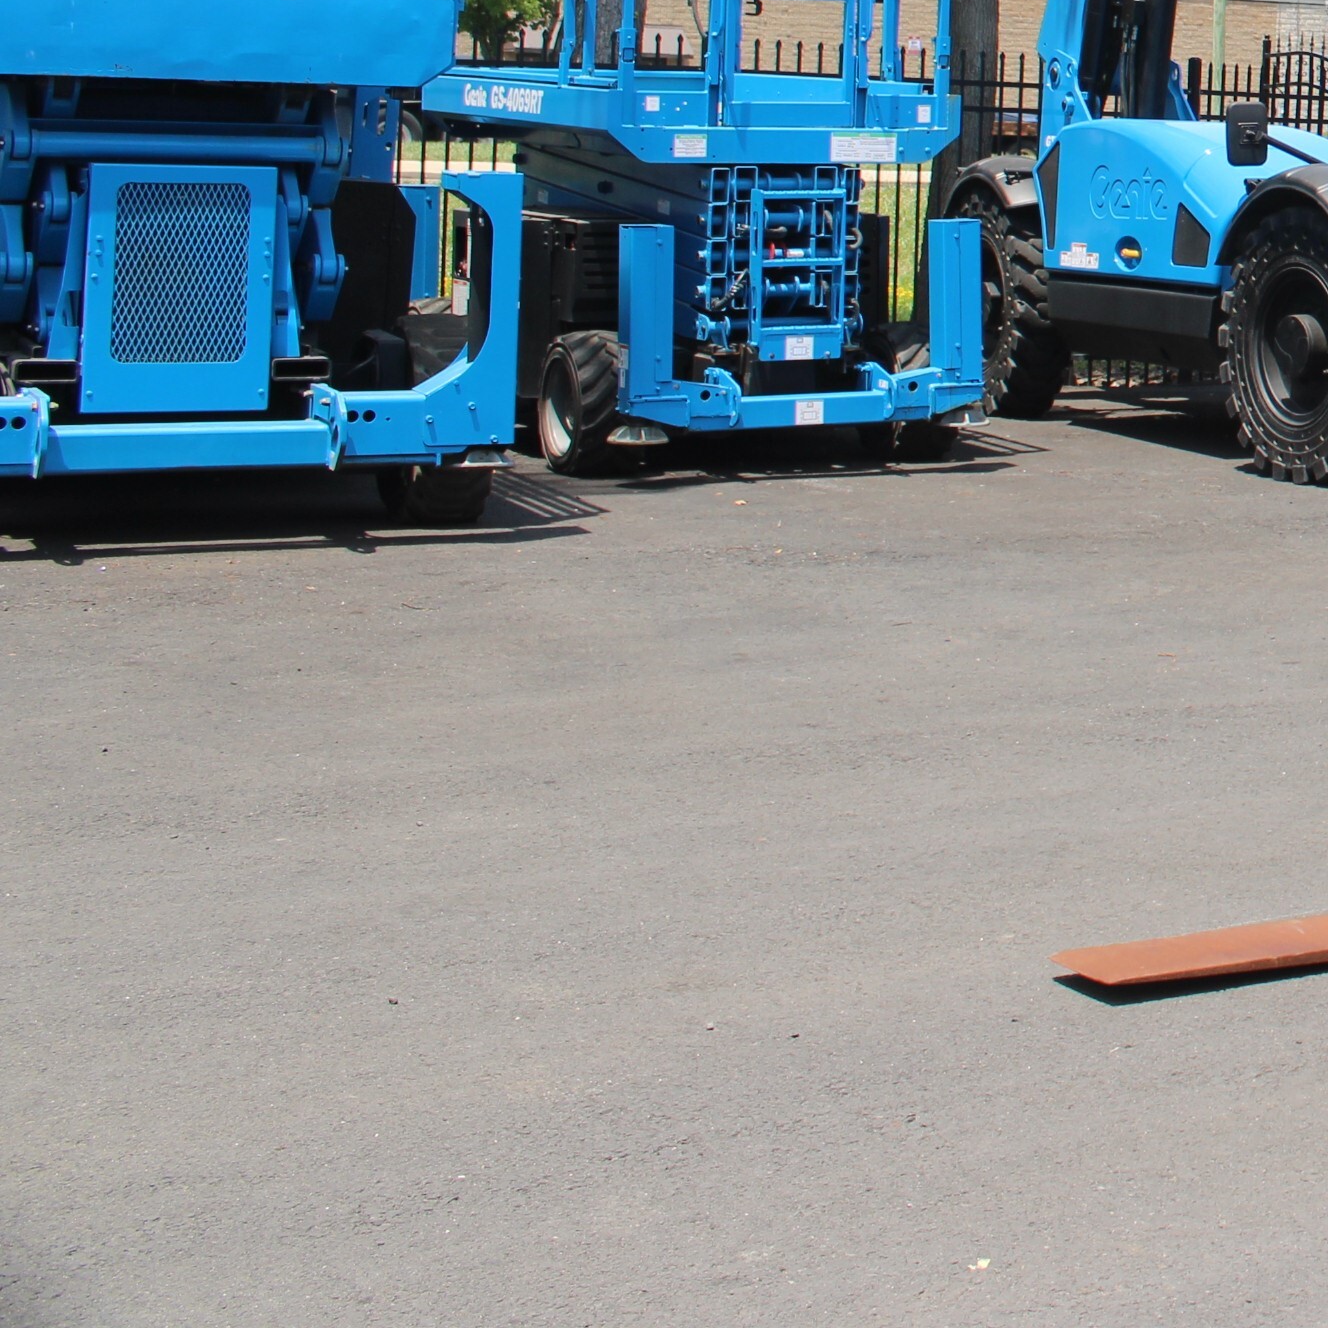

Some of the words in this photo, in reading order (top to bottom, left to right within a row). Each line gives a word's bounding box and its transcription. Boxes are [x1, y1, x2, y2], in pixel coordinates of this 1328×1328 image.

[464, 83, 487, 108] Genie
[491, 85, 544, 114] GS-4069RT
[1089, 164, 1168, 220] Genie
